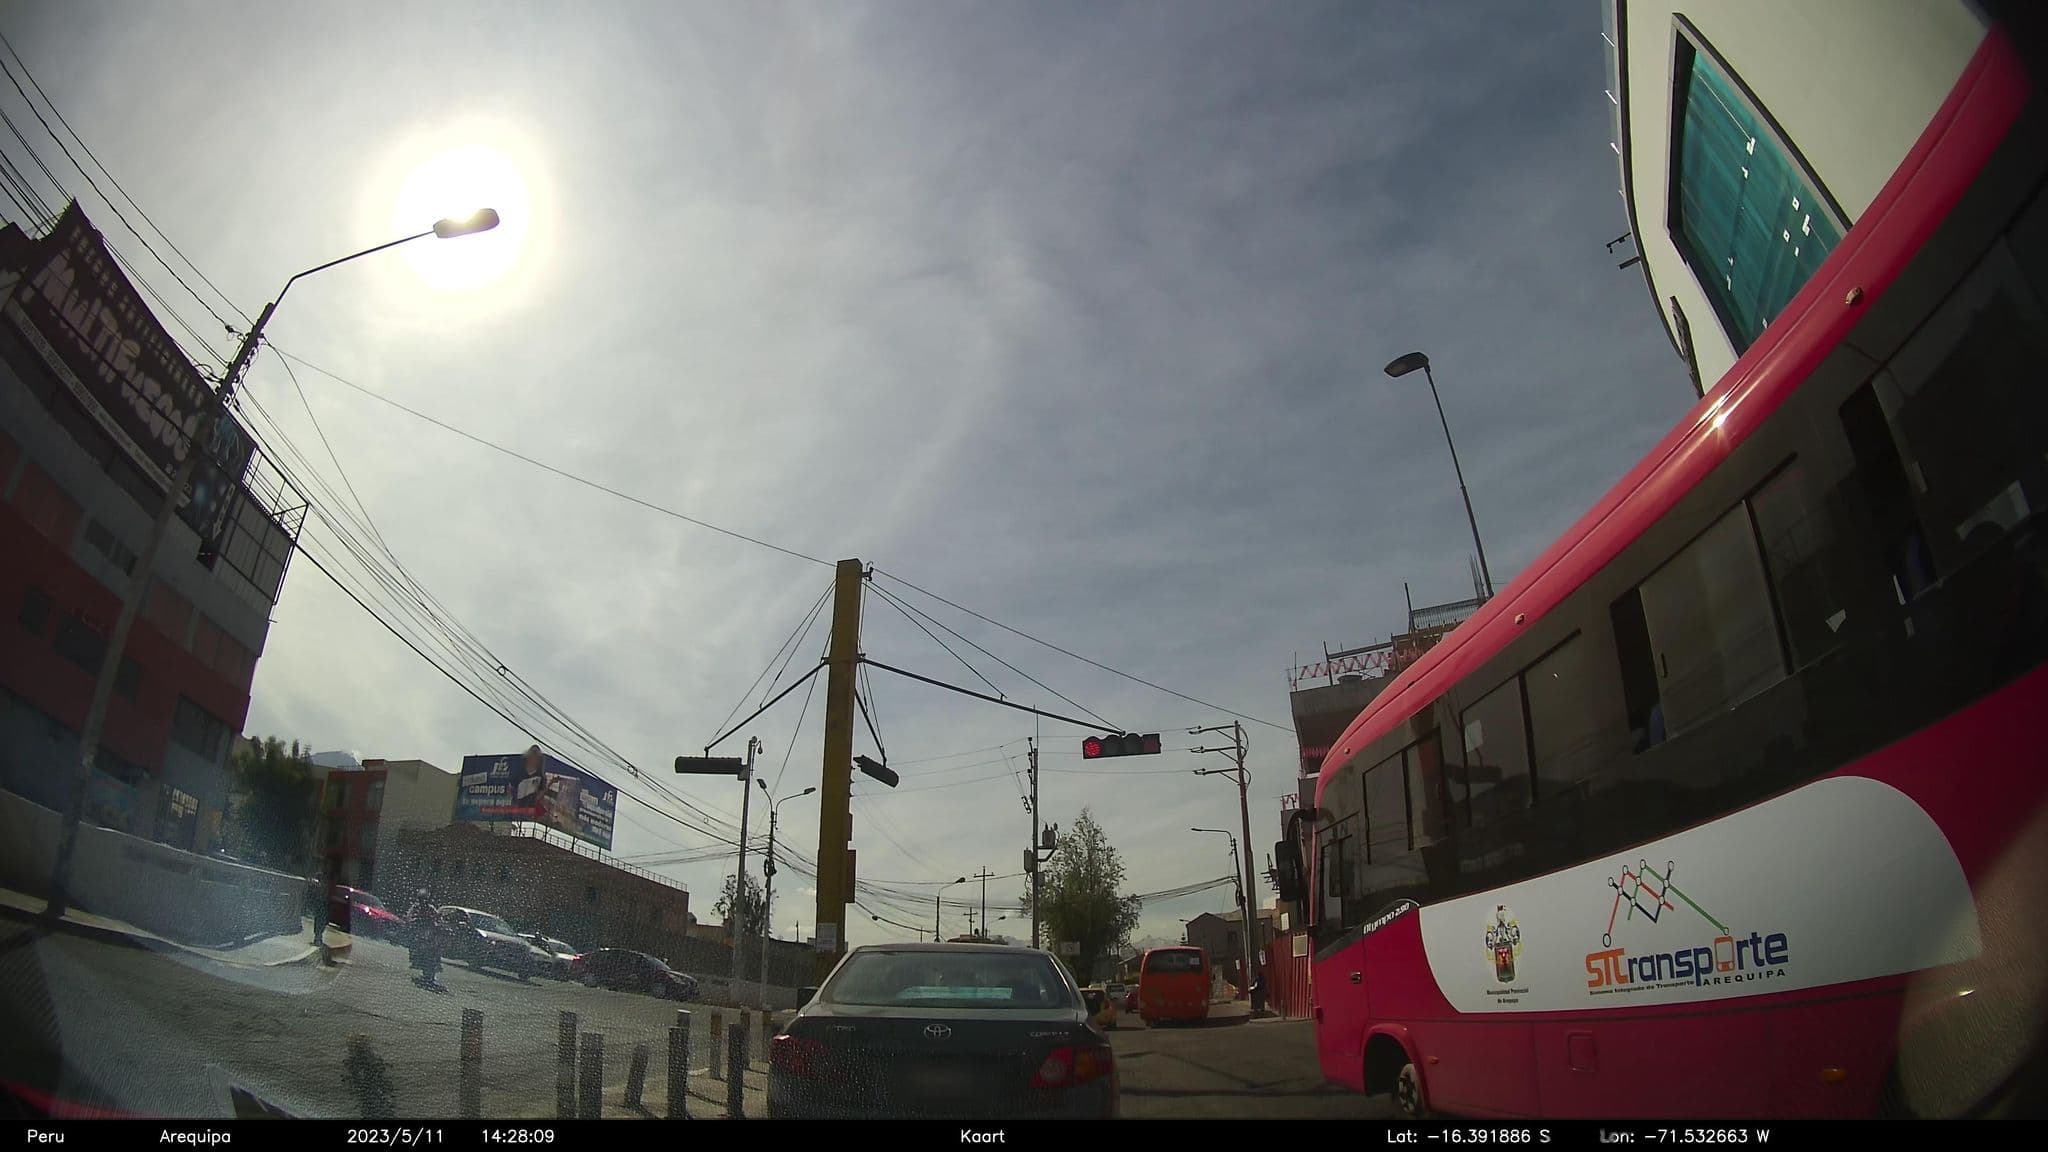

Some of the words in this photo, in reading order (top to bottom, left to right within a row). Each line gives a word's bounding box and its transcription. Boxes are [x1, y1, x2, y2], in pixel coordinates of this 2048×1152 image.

[469, 785, 506, 796] campus
[1703, 968, 1787, 987] AREQUIPA
[1656, 980, 1695, 990] Transporte
